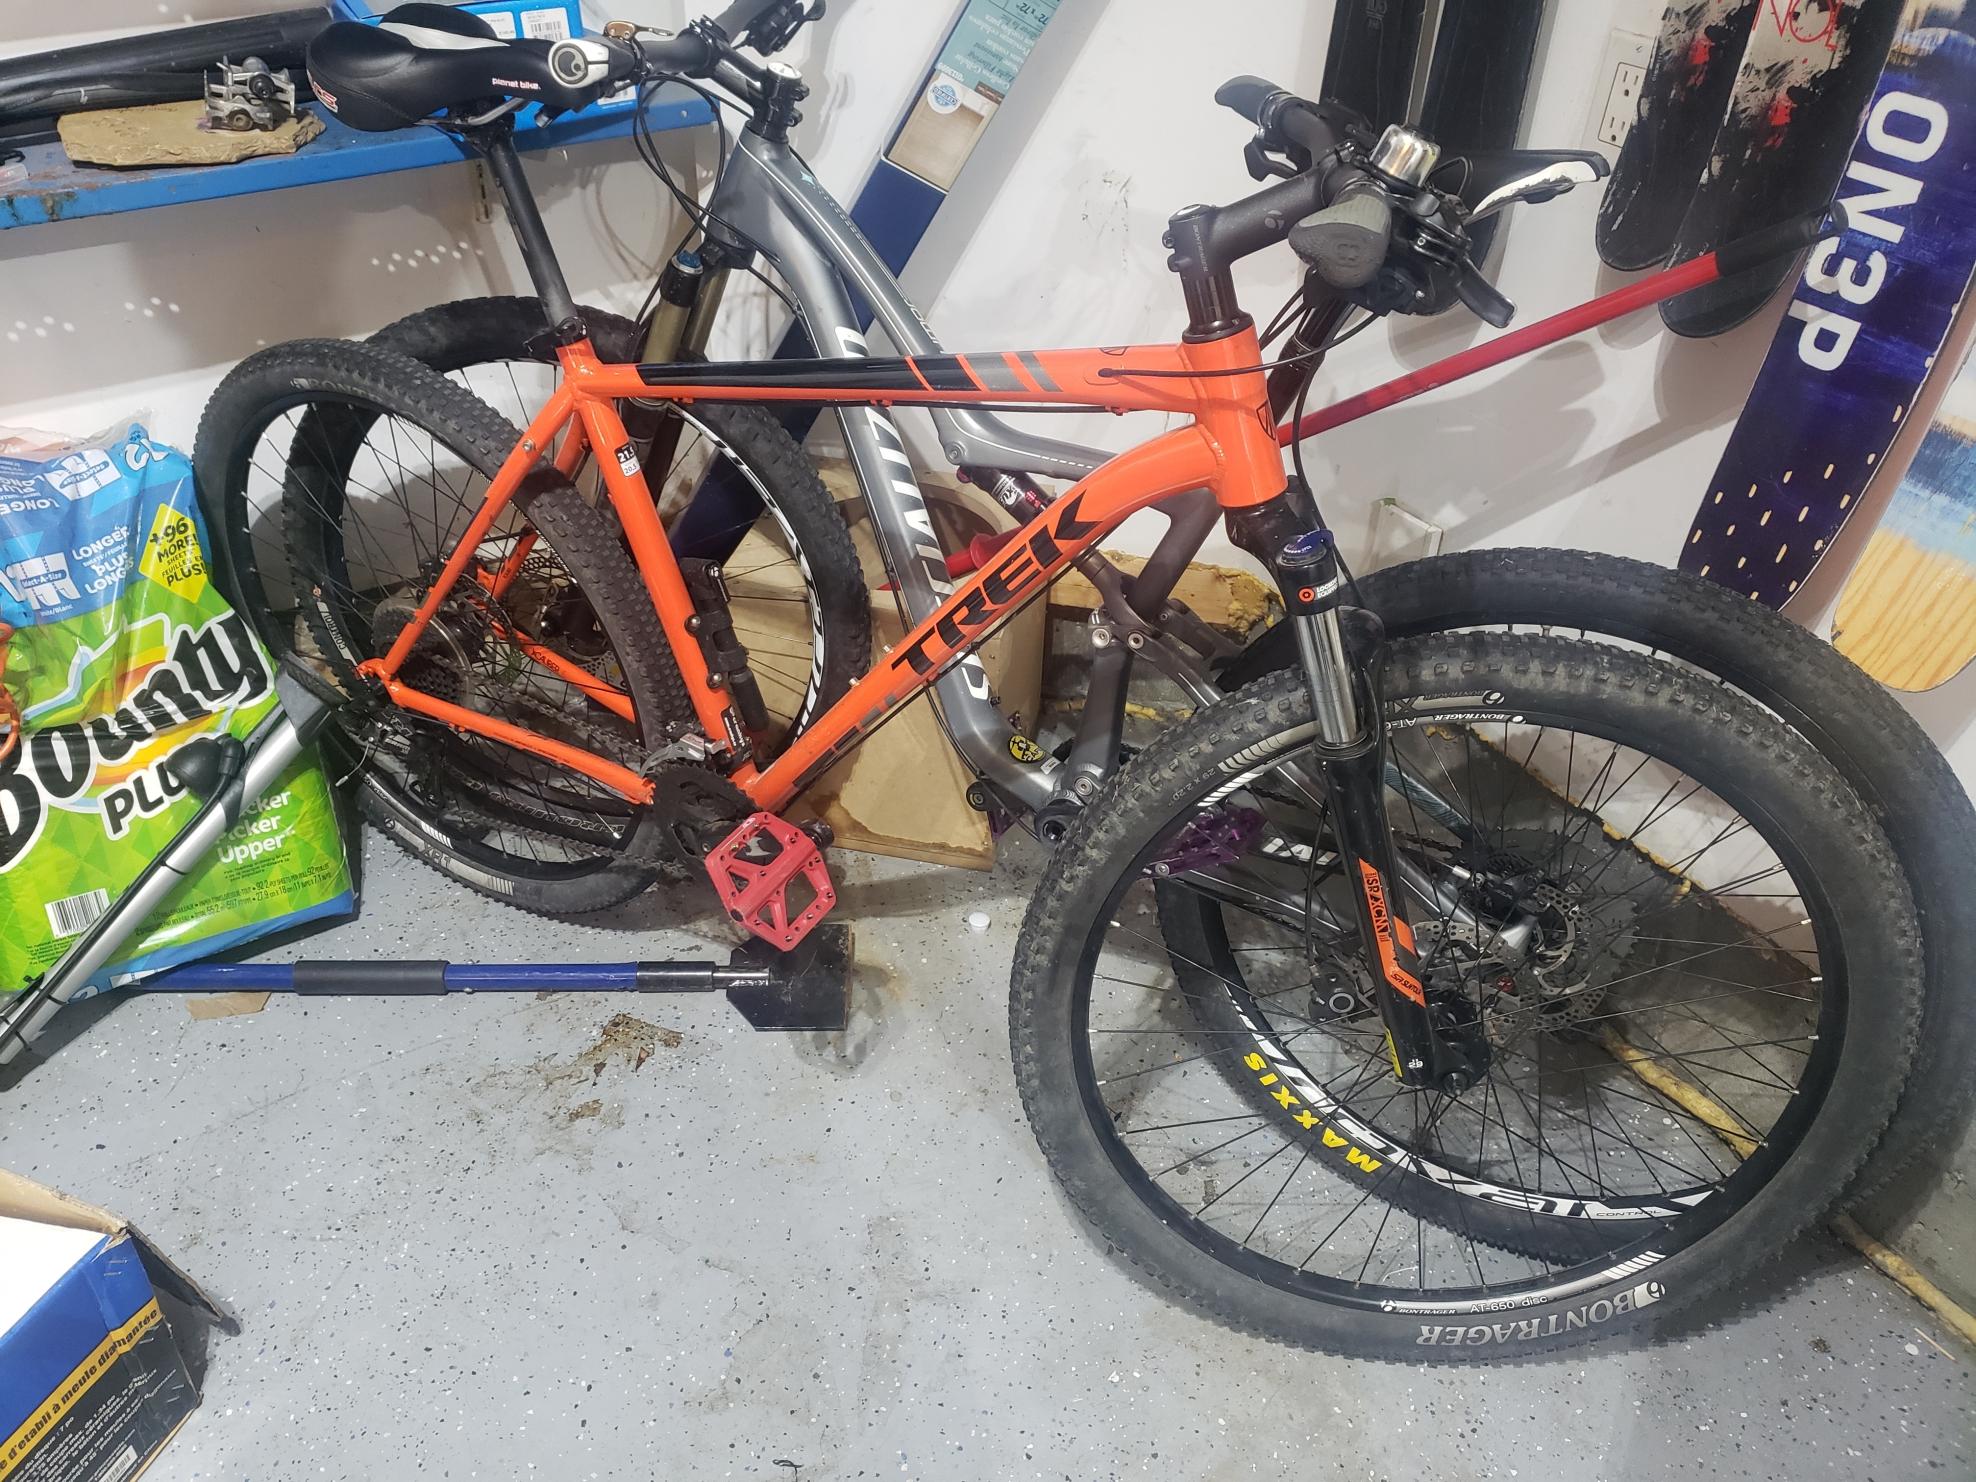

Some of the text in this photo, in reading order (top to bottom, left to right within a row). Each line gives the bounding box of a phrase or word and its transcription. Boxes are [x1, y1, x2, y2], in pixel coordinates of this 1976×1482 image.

[491, 77, 519, 89] planet
[1794, 90, 1948, 374] ON3P
[0, 497, 60, 516] LONGE
[150, 516, 190, 545] +96
[157, 532, 200, 563] MORE!
[166, 562, 209, 587] PLUS!
[890, 490, 1102, 675] TREK
[103, 764, 189, 835] PLU
[217, 833, 286, 865] Upper
[1243, 1053, 1383, 1175] MAXXIS
[1595, 1208, 1663, 1218] CONTROL
[1399, 1295, 1549, 1316] BONTRAGER AT-650 disc
[1416, 1286, 1638, 1347] BONTRAGER
[58, 1364, 99, 1405] meule
